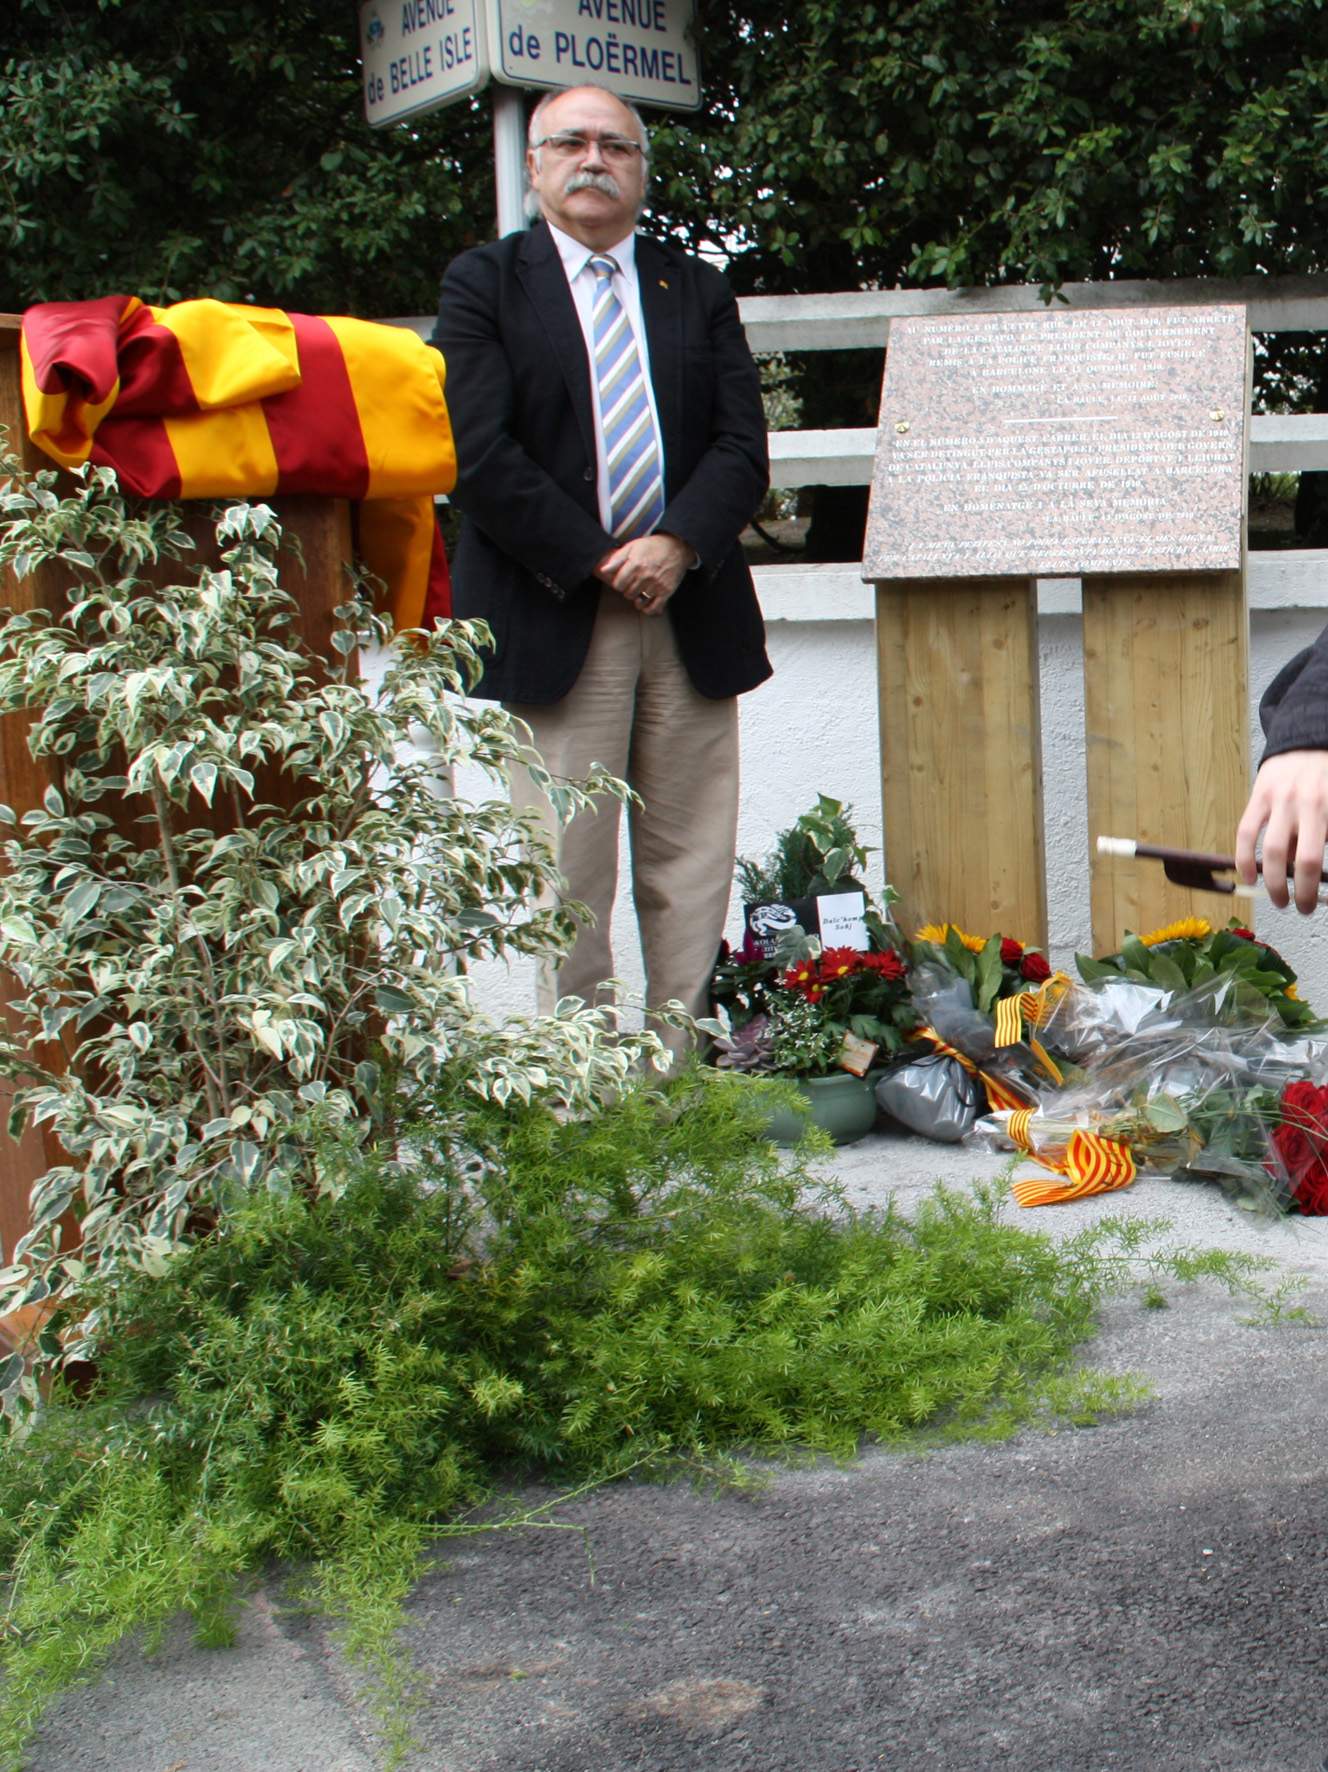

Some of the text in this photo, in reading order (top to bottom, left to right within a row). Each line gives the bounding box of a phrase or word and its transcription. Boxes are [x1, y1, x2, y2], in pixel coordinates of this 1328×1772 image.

[578, 0, 667, 32] AVENUE
[367, 26, 472, 105] de BELLE ISLE
[508, 24, 692, 85] de PLOËRMEL
